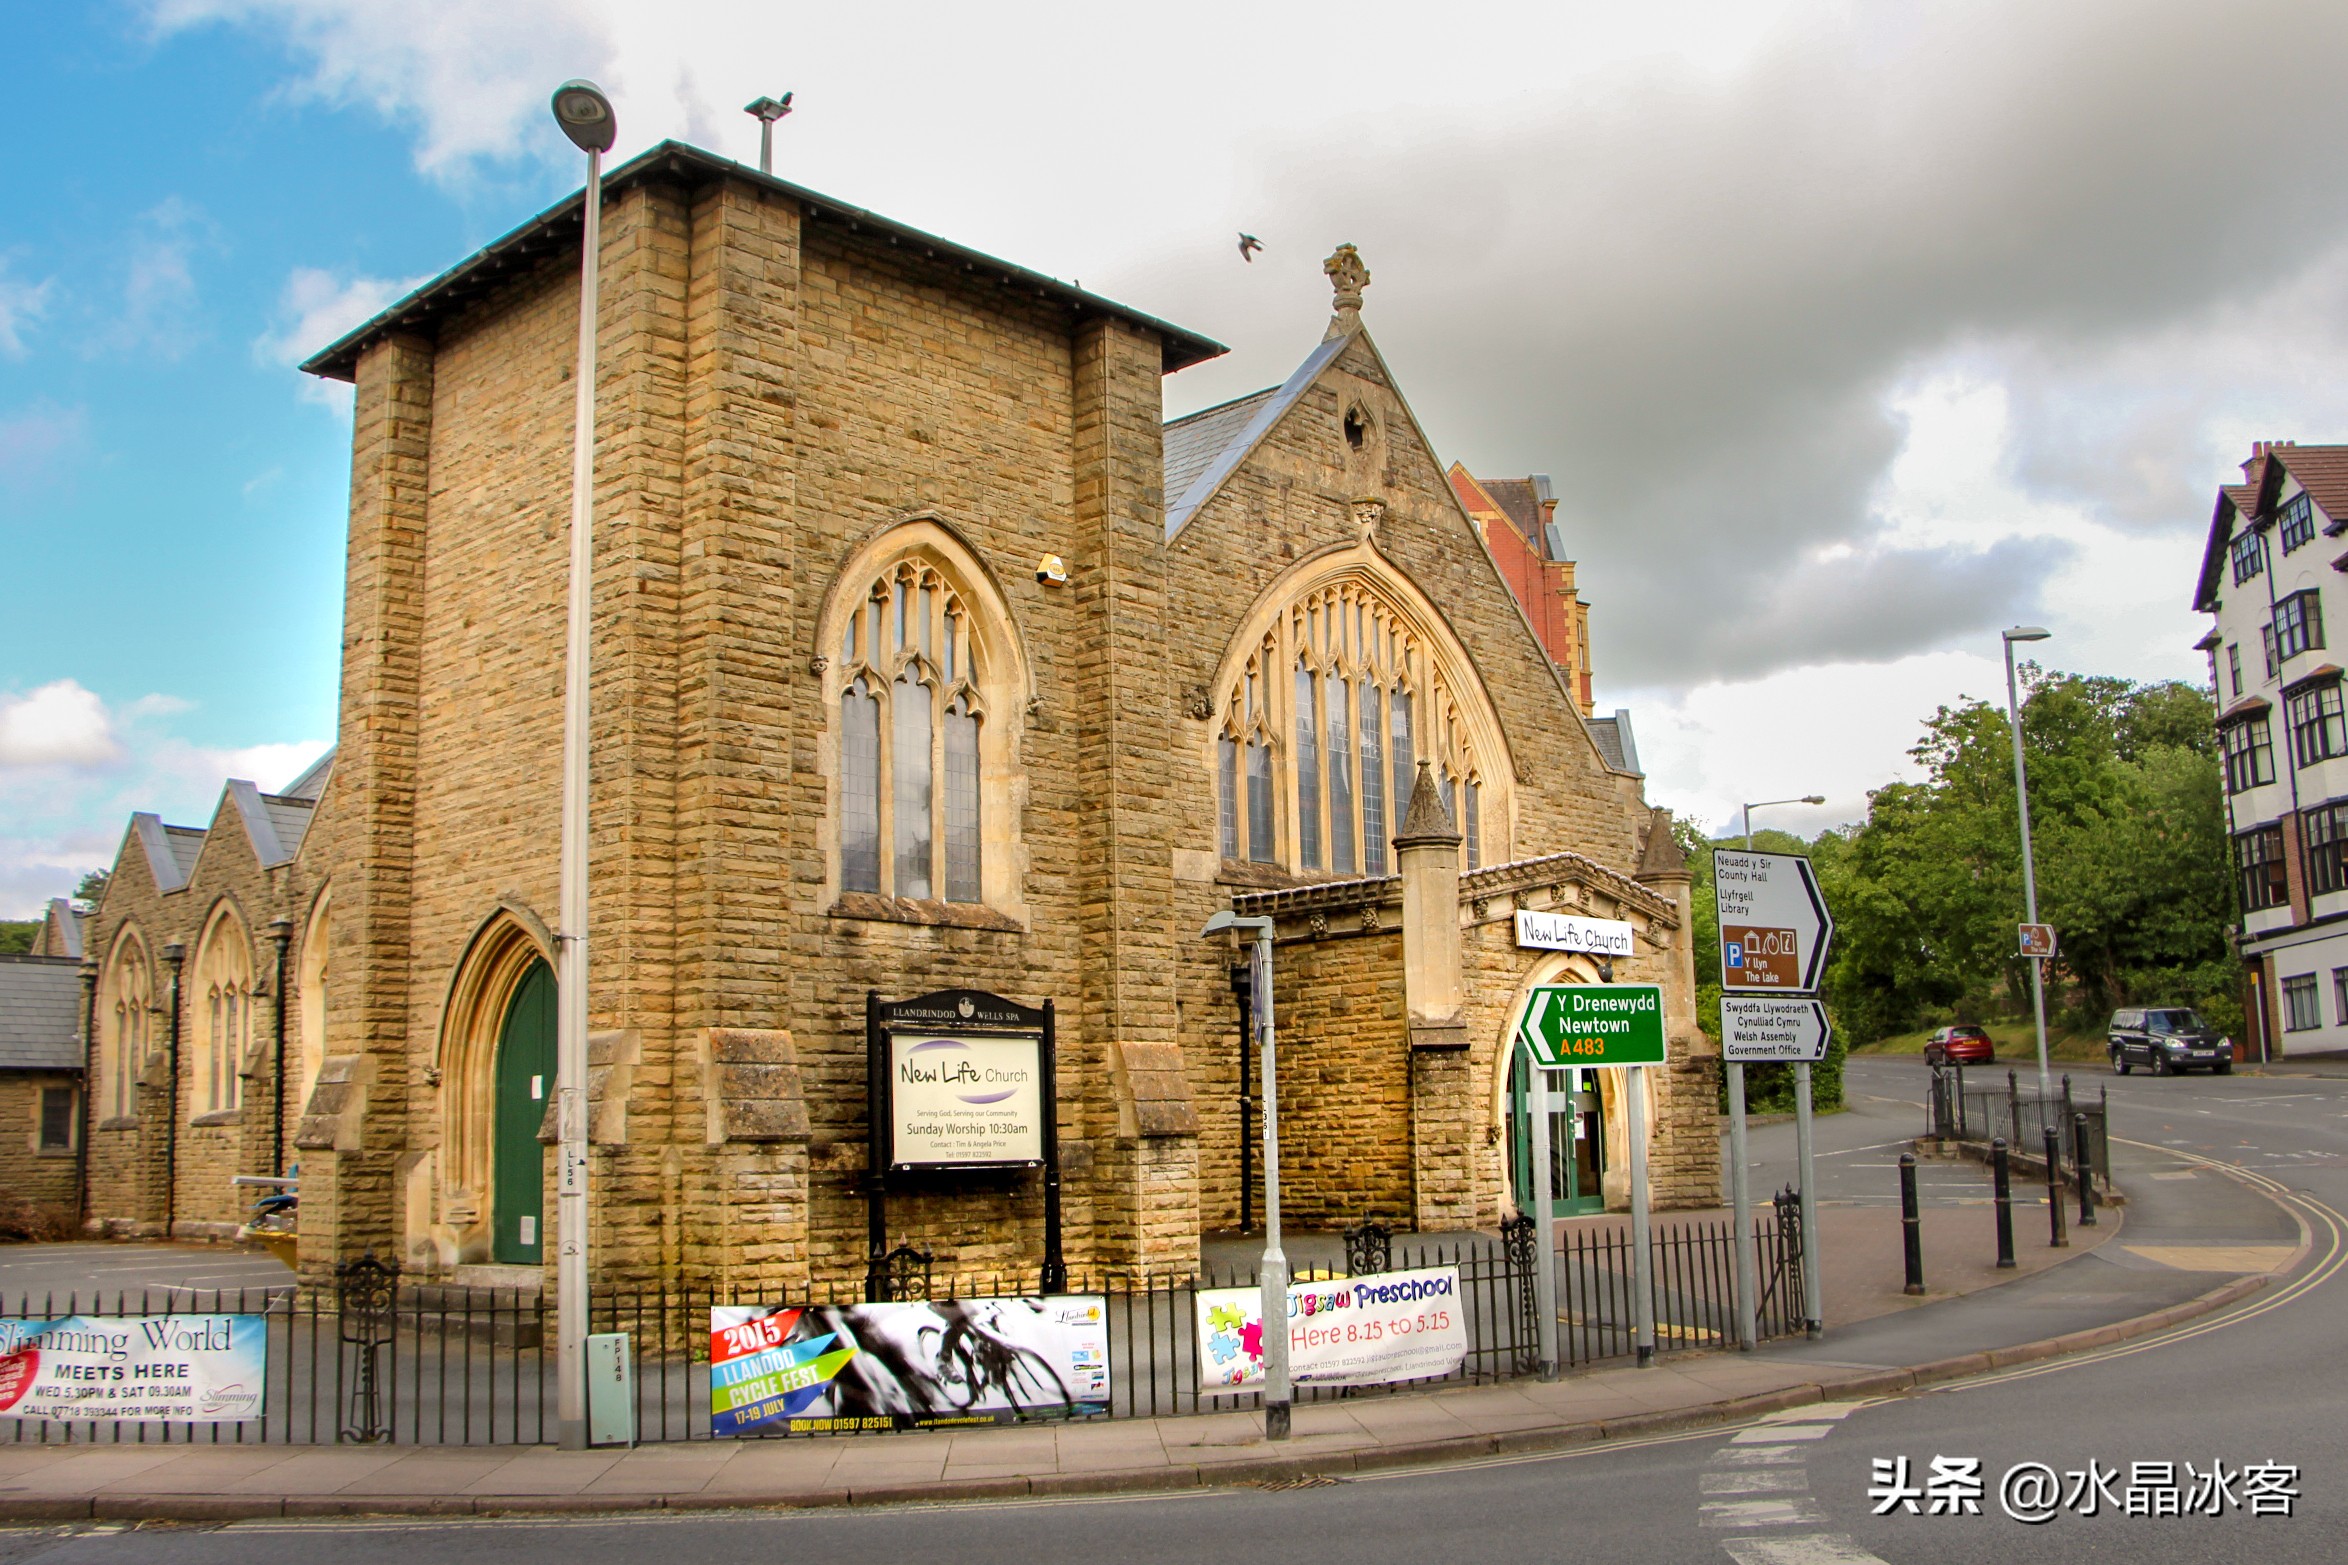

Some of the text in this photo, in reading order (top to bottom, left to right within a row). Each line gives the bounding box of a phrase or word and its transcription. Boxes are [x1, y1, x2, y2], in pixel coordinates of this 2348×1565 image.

[1718, 855, 1771, 869] Neuadd y Sir
[1719, 869, 1767, 882] County Hall
[1720, 889, 1754, 903] Llyfrgell
[1721, 903, 1749, 916] Library
[1524, 915, 1628, 950] New Life Church
[1729, 944, 1740, 966] P
[1744, 957, 1768, 970] Y llyn
[1745, 971, 1779, 983] The lake
[1556, 994, 1656, 1014] Y Drenewydd
[1726, 1002, 1809, 1015] Swyddfa Llywodraeth
[893, 1007, 1020, 1021] LLANDRINDOD WELLS SPA
[1559, 1017, 1630, 1034] Newtown
[1737, 1017, 1801, 1028] Cynulliad Cymru
[1734, 1031, 1797, 1043] Welsh Assembly
[1728, 1045, 1801, 1055] Government Office
[901, 1058, 1028, 1084] New Life Church
[917, 1110, 938, 1118] Serving
[954, 1110, 974, 1118] Serving
[986, 1110, 1018, 1118] Community
[907, 1123, 1028, 1137] Sunday Worship 10:30am
[973, 1141, 992, 1149] Angela
[993, 1140, 1007, 1148] Price
[1287, 1276, 1453, 1318] Jigsaw Preschool
[139, 1318, 231, 1351] World
[723, 1317, 782, 1356] 2015
[1291, 1311, 1450, 1351] Here 8.15 to 5.15
[614, 1339, 622, 1382] FP148
[722, 1348, 796, 1387] LLANDOD
[55, 1364, 189, 1380] MEETS HERE
[35, 1385, 192, 1399] WED 5.30PM & SAT 09.30AM
[729, 1365, 820, 1408] CYCLE FEST
[23, 1405, 193, 1417] CALL 07718 393344 FOR MORE INFO
[734, 1398, 785, 1425] 17-19 JULY
[790, 1416, 893, 1431] BOOK NOW 01597 825151
